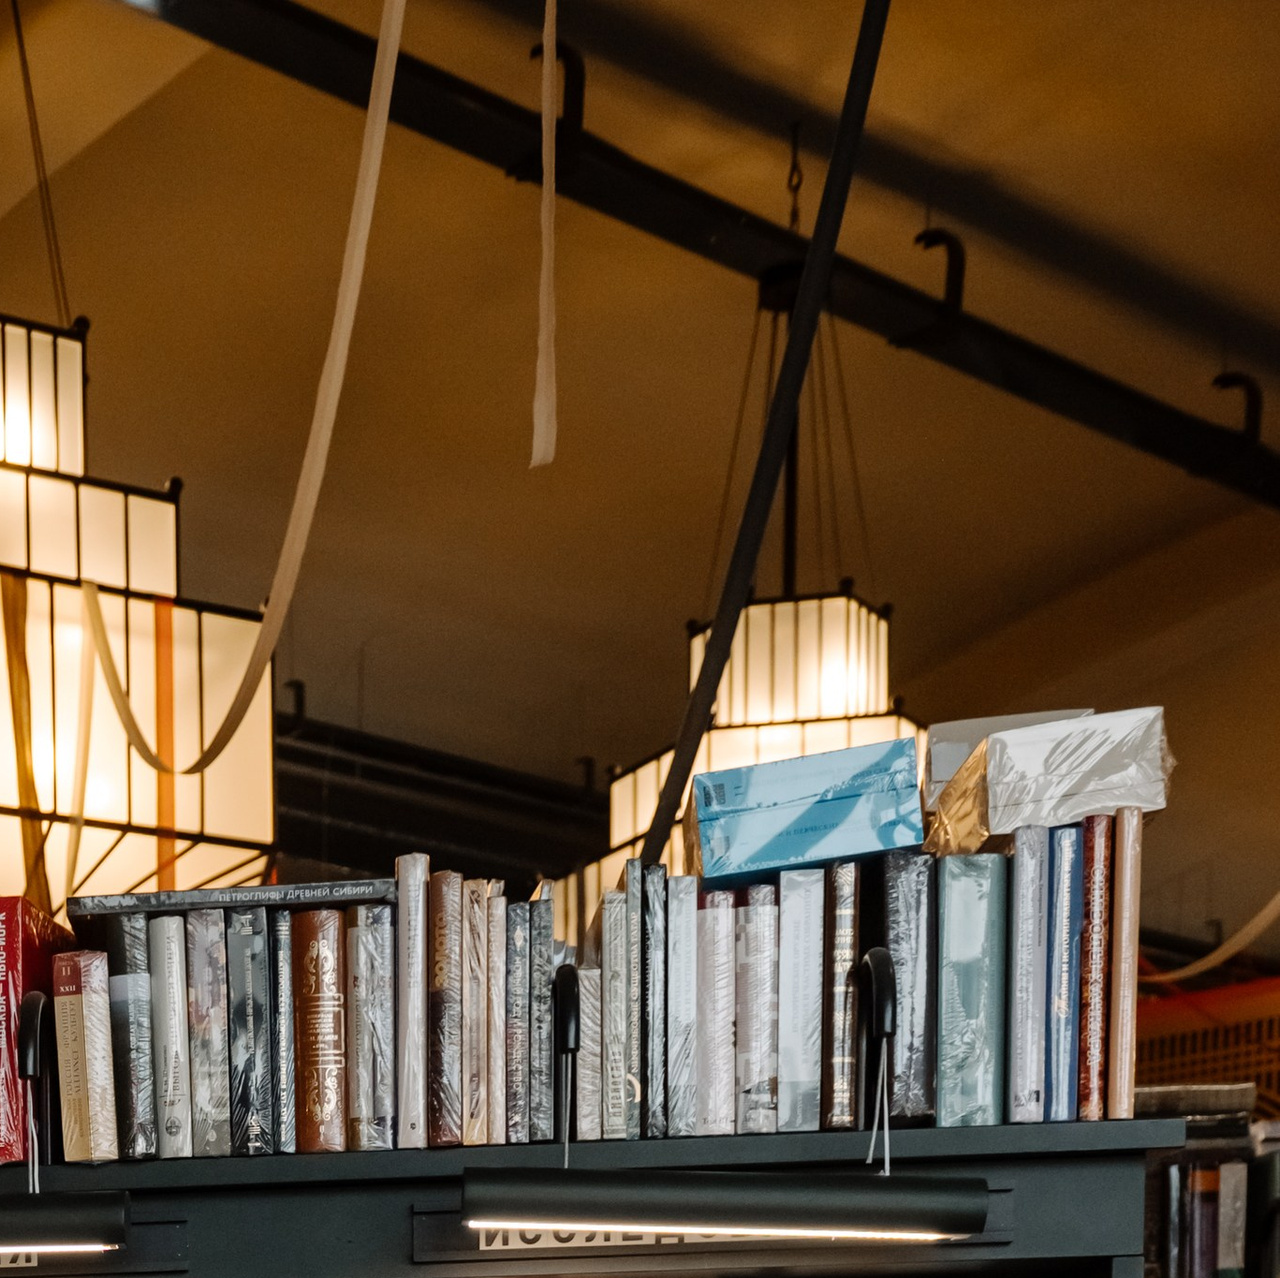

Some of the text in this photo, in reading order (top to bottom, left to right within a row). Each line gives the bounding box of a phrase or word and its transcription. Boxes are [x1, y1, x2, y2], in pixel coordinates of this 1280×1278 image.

[218, 885, 373, 903] ПЕТРОГЛИФЫ ДРЕВНЕЙ СИБИРИ
